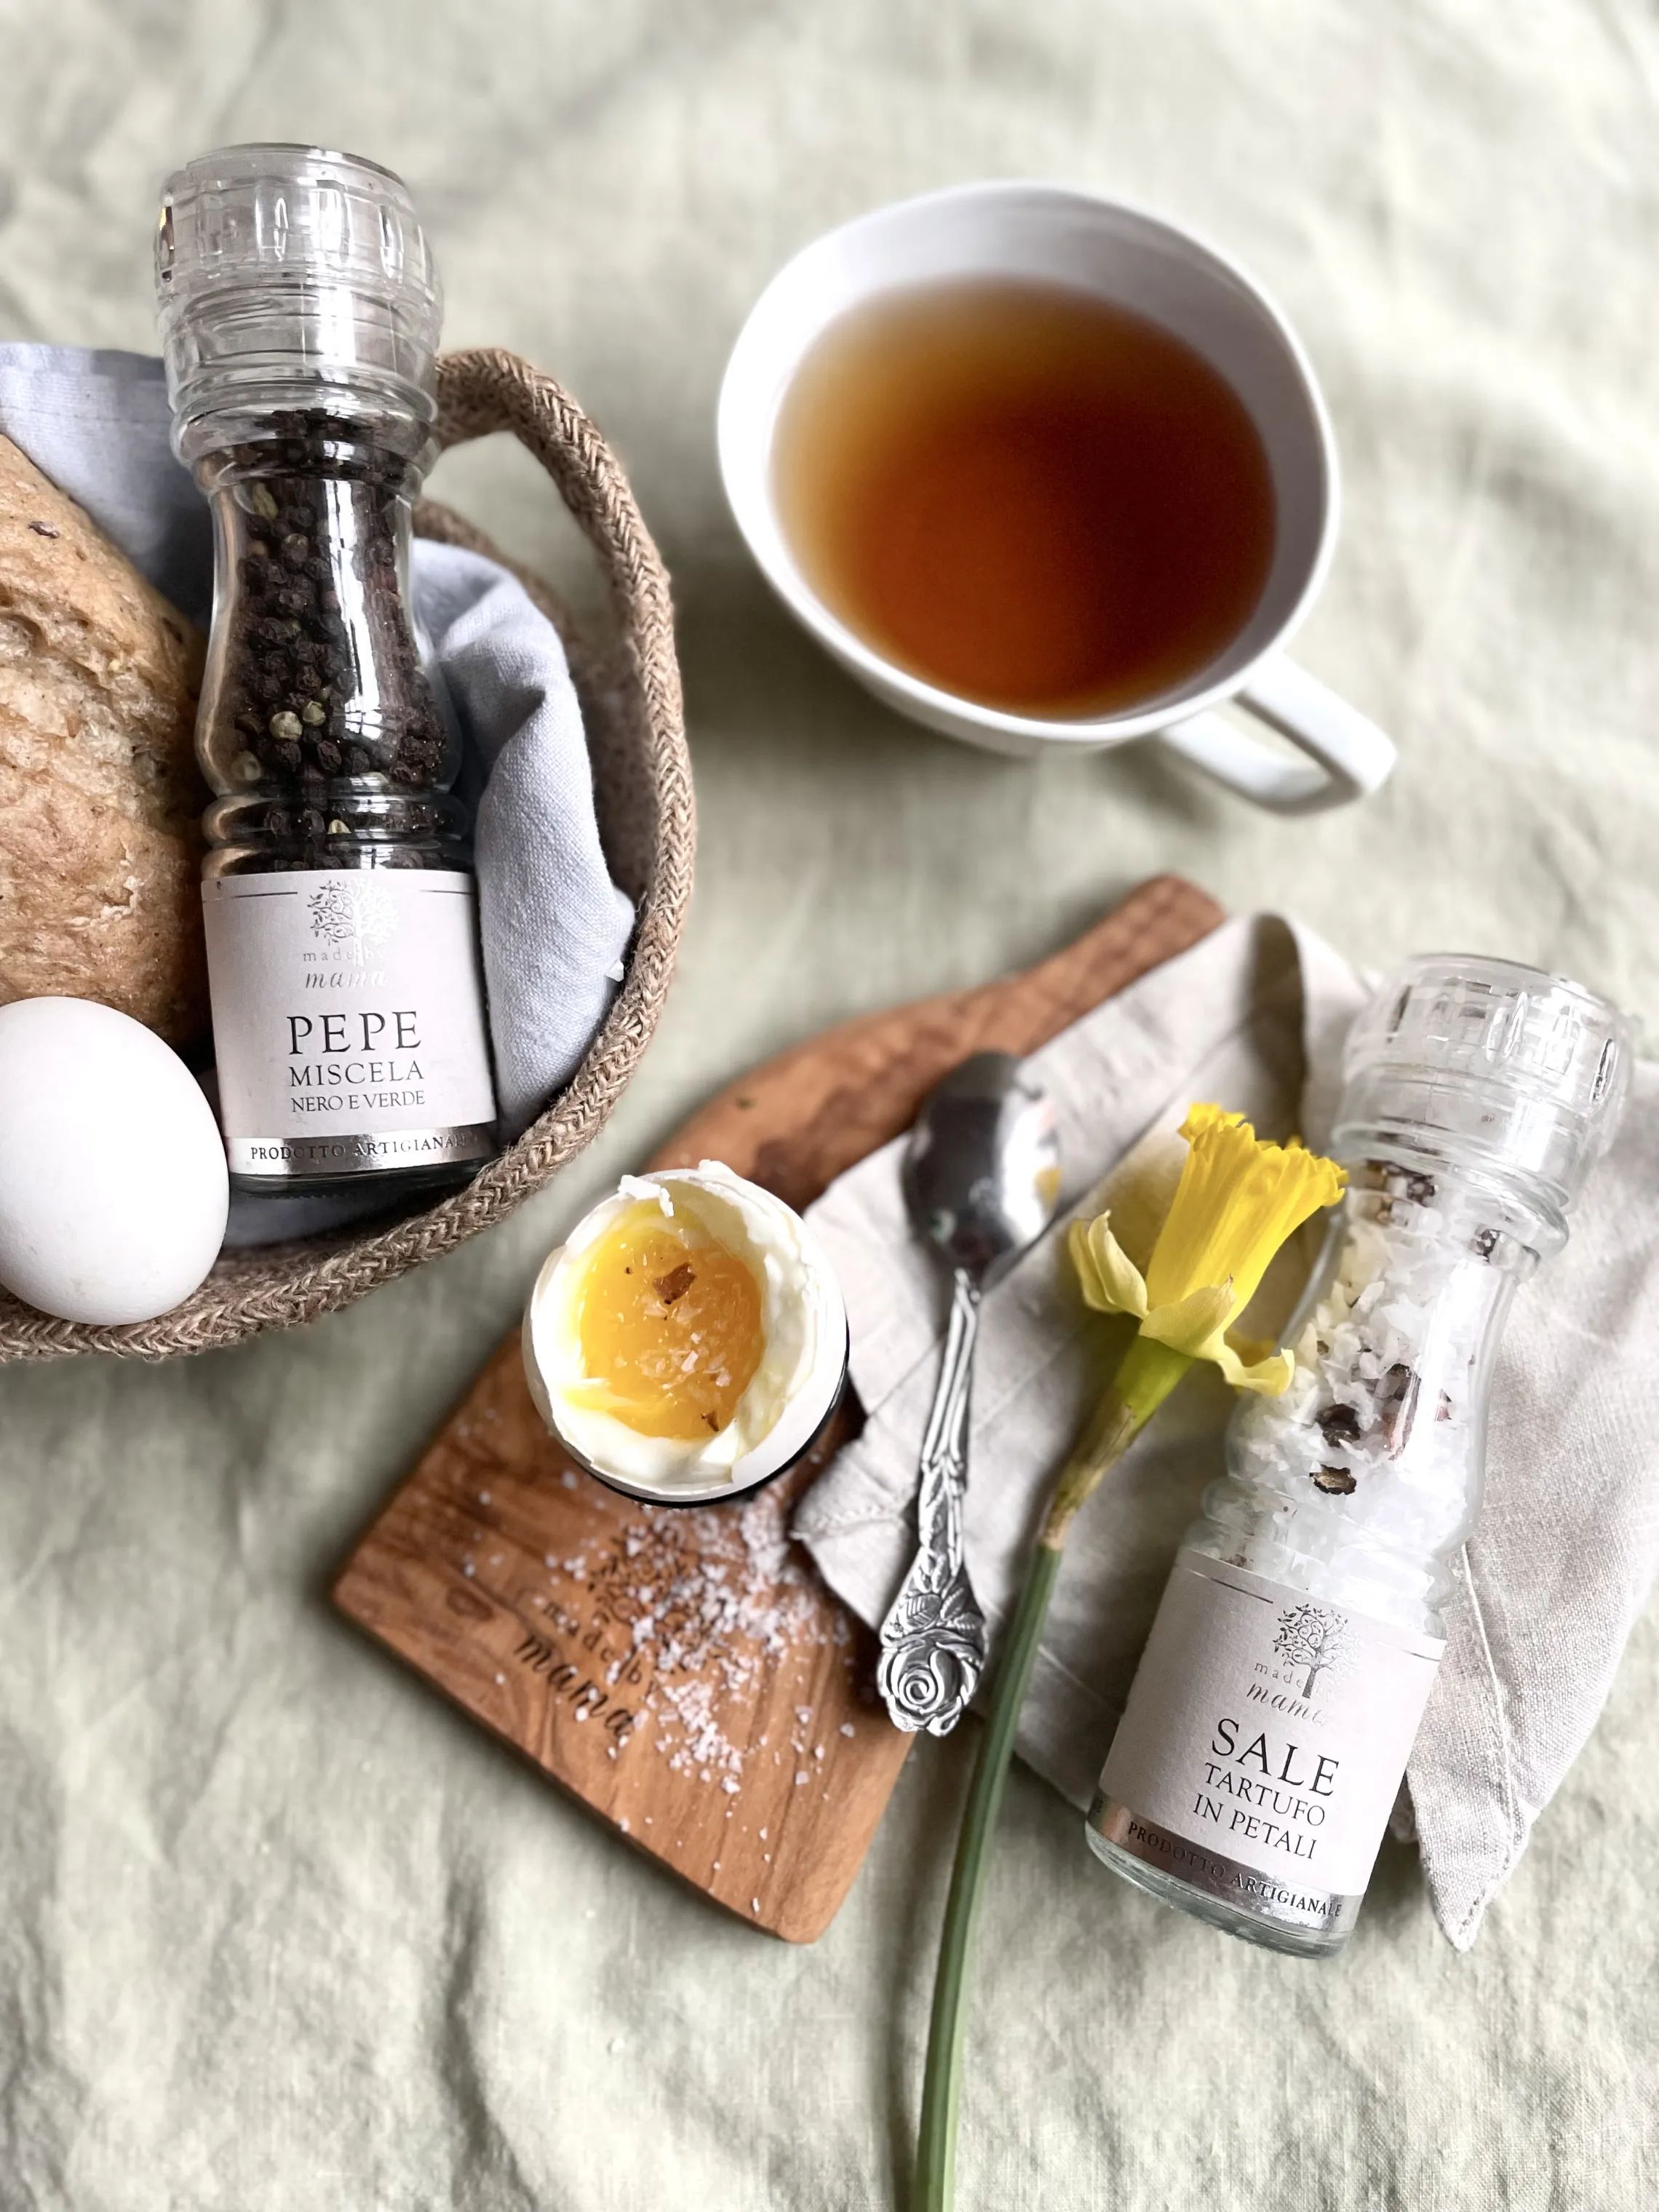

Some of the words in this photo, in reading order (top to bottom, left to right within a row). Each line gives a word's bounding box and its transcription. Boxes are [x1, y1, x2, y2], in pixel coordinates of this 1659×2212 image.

[286, 1010, 421, 1055] PEPE
[289, 1059, 425, 1087] MISCELA
[290, 1094, 343, 1113] NERO
[349, 1094, 361, 1110] E
[363, 1090, 426, 1109] VERDE
[250, 1142, 346, 1161] PRODOTTO
[1212, 1718, 1340, 1797] SALE
[1204, 1762, 1326, 1827] TARTUFO
[1192, 1794, 1224, 1823] IN
[1229, 1809, 1318, 1860] PETALI
[1127, 1821, 1225, 1877] PRODOTTO
[1231, 1872, 1342, 1917] ARTIGIANALE
